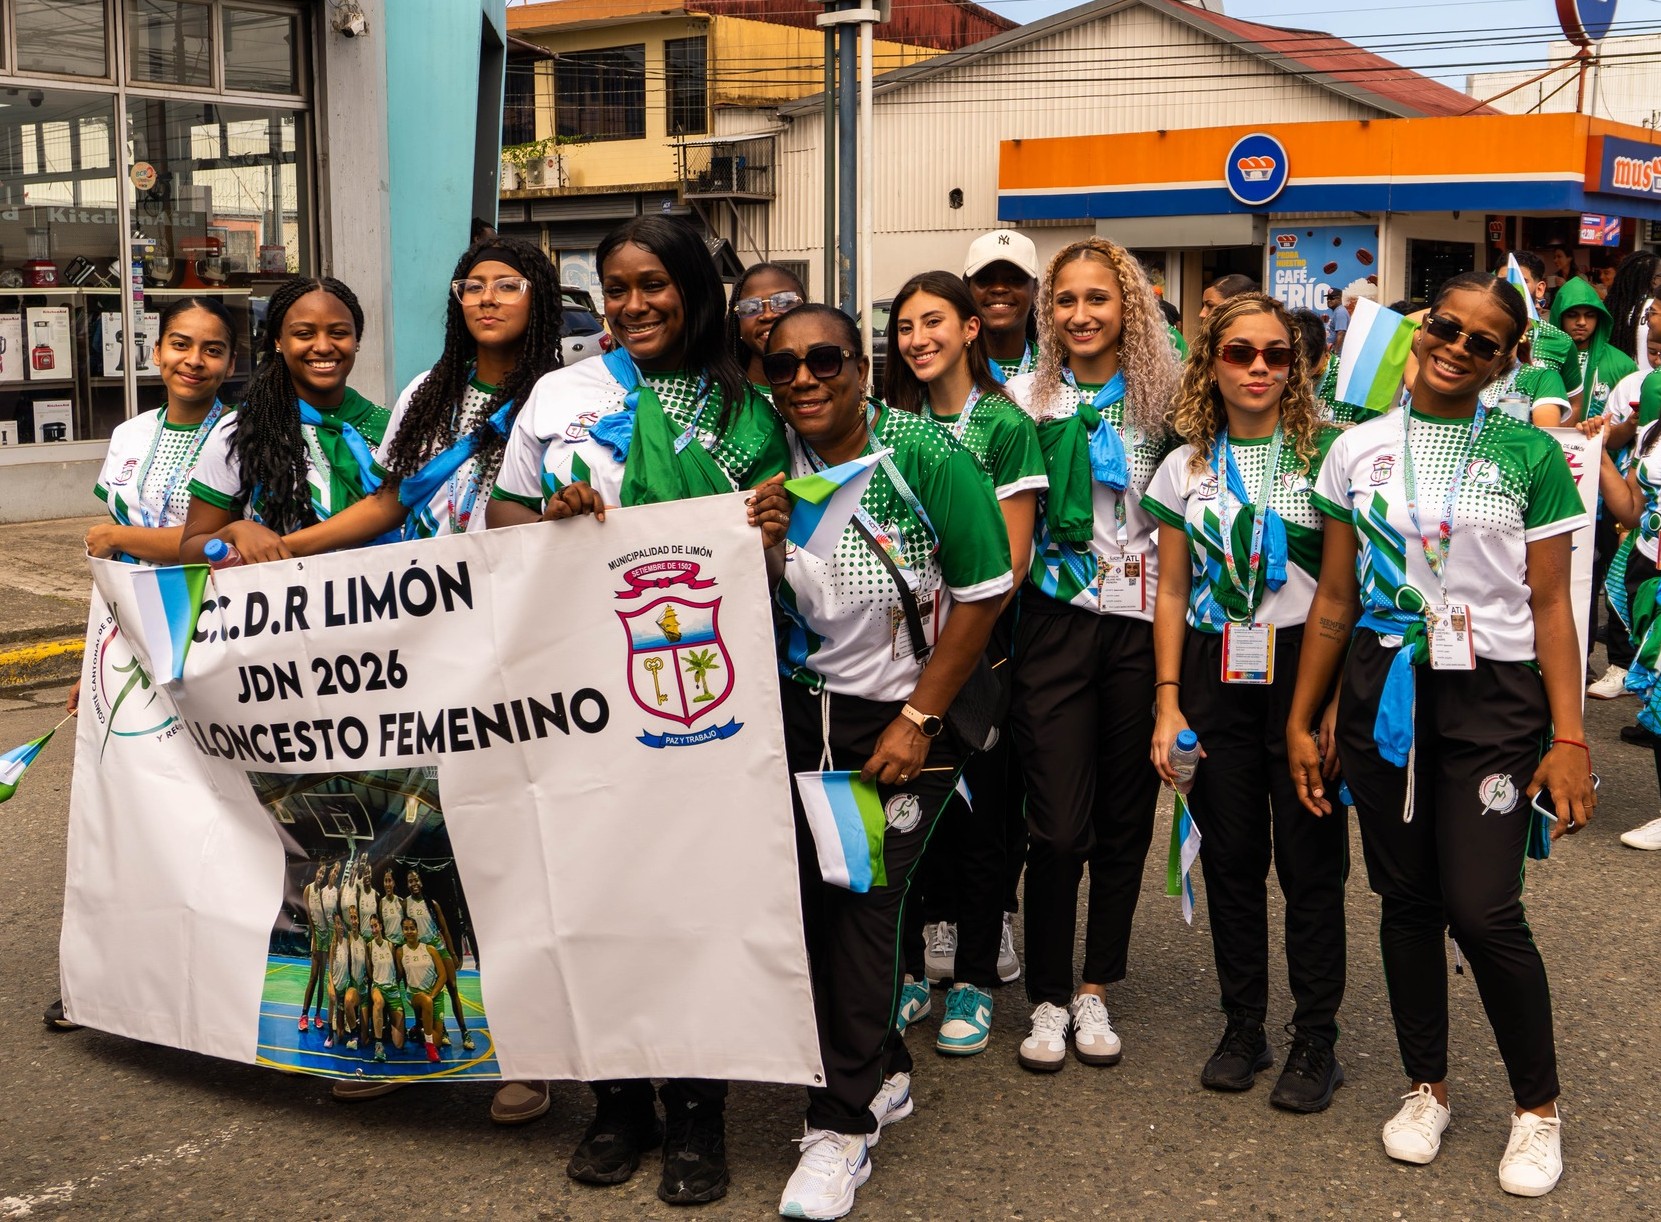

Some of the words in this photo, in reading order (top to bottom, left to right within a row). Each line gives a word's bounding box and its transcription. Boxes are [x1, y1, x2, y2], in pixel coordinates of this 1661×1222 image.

[998, 234, 1010, 245] NY
[1275, 266, 1308, 284] CAFÉ
[608, 545, 670, 571] MUNICIPALIDAD
[672, 545, 683, 554] DE
[685, 545, 713, 558] LIMÓN
[631, 562, 667, 578] SETIEMBRE
[678, 562, 692, 571] 1502
[325, 559, 473, 628] LIMÓN
[1451, 606, 1465, 614] ATL
[91, 638, 101, 692] CANTONAL
[98, 623, 107, 635] DE
[238, 660, 303, 703] JDN
[311, 649, 408, 697] 2026
[379, 687, 610, 757] FEMENINO
[665, 736, 679, 744] PAZ
[685, 730, 717, 744] TRABAJO
